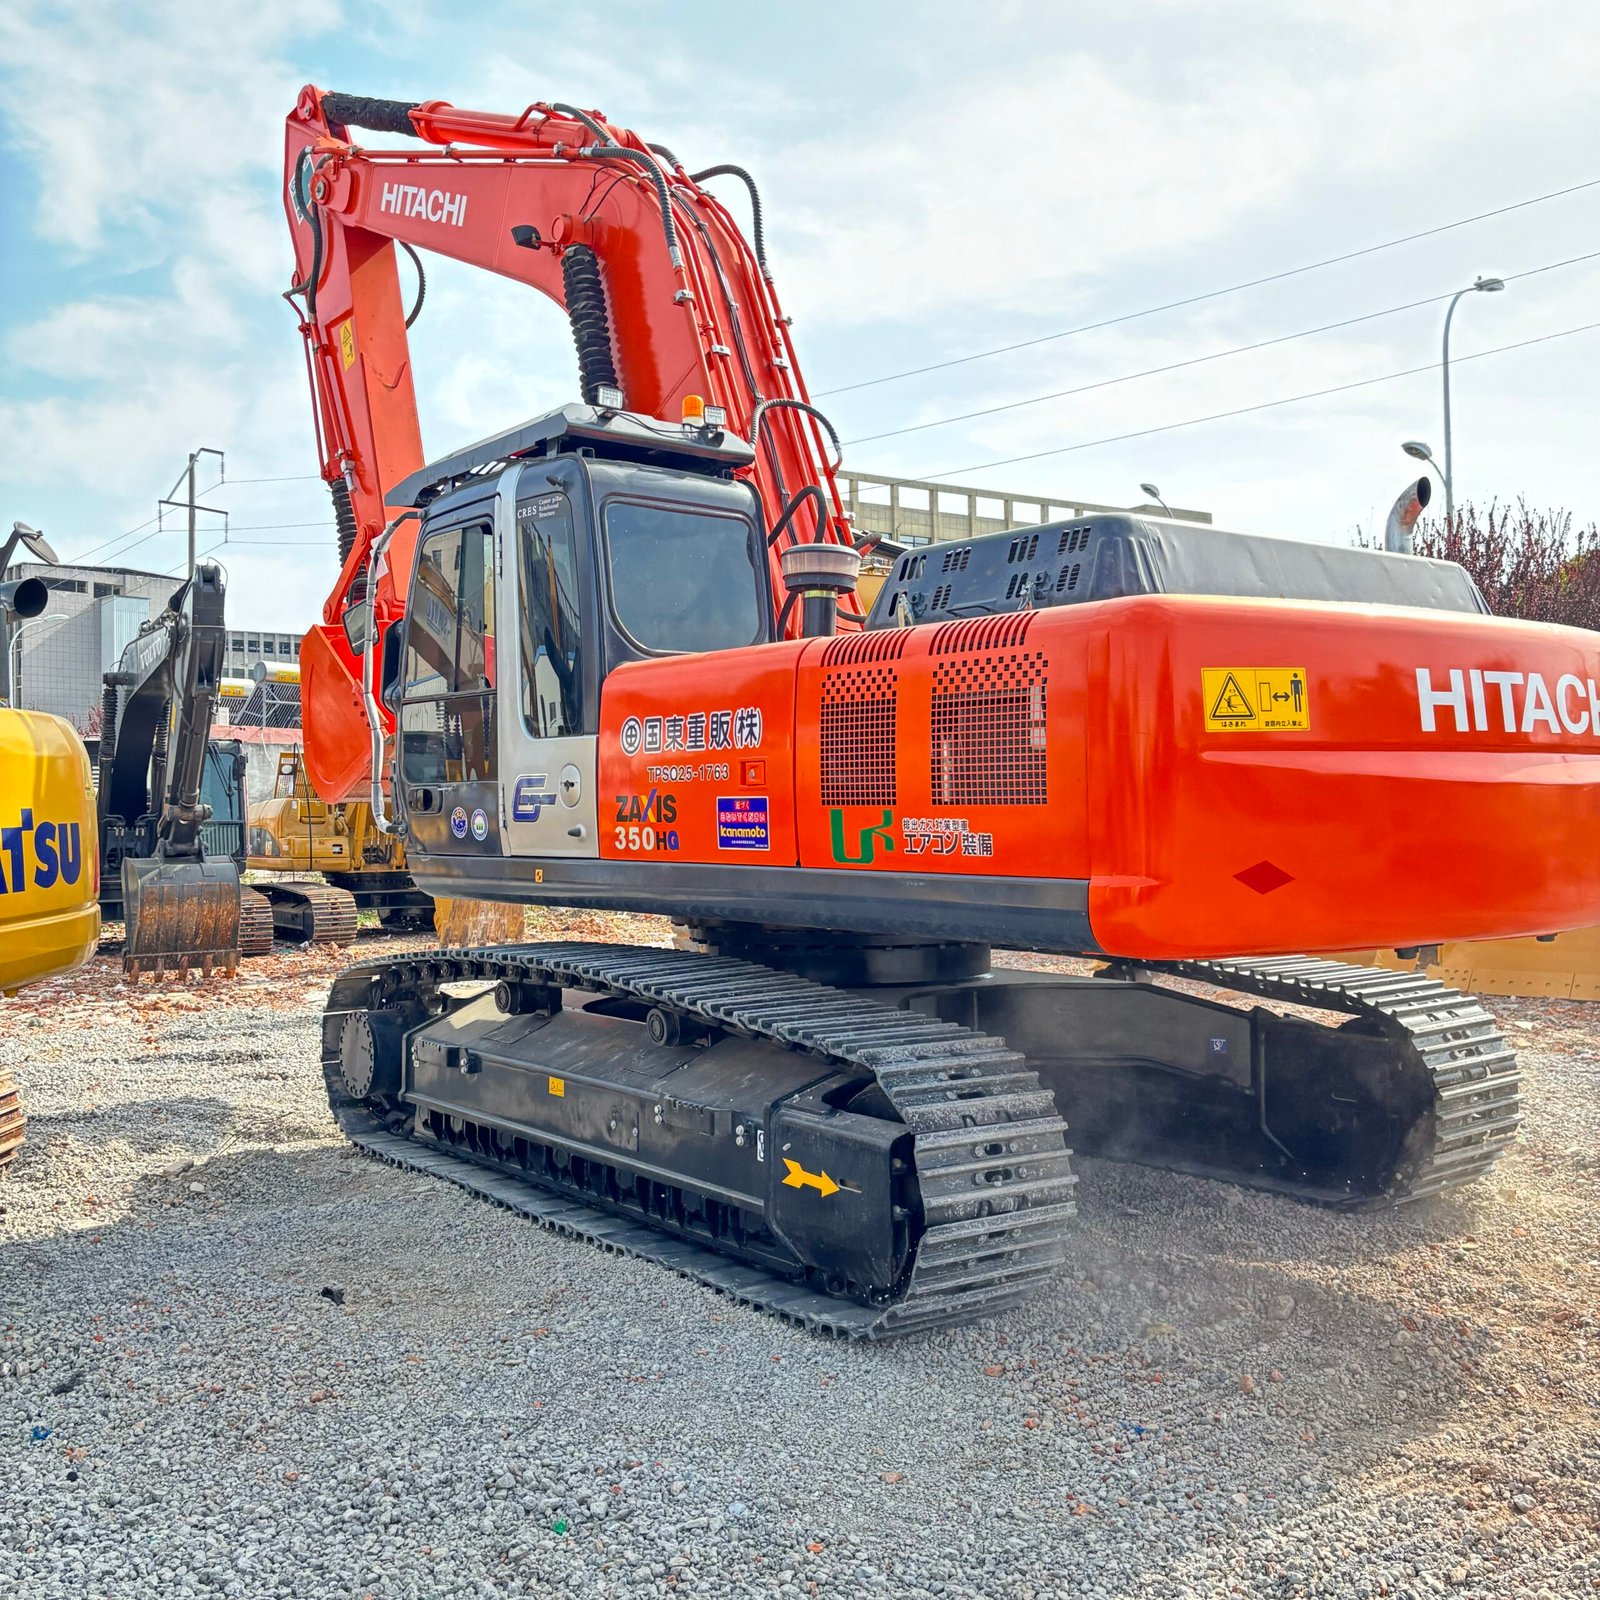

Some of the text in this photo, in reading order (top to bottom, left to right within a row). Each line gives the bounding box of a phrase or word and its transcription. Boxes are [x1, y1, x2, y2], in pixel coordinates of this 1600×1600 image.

[380, 182, 467, 227] HITACHI
[517, 505, 537, 519] CRES
[615, 788, 678, 824] ZAXIS
[720, 825, 766, 838] kanamoto
[0, 808, 82, 894] TSU
